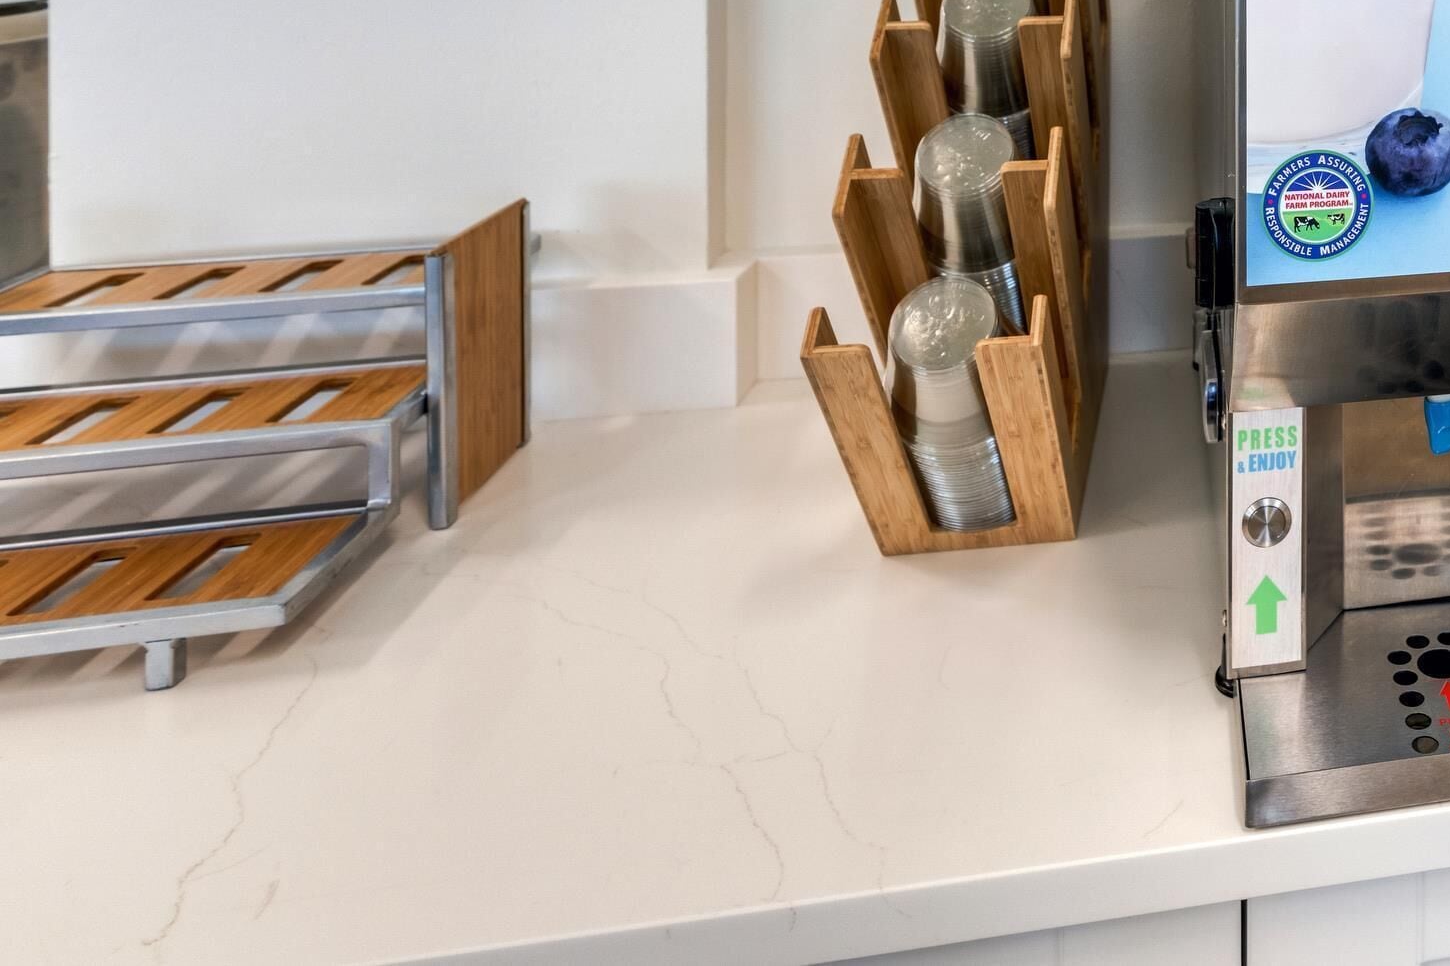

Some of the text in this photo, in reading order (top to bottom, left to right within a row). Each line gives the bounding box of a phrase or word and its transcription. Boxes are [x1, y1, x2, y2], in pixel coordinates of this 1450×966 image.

[1268, 155, 1366, 196] FARMERS ASSURING
[1284, 191, 1350, 201] NATIONAL DAIRY
[1285, 200, 1349, 209] FARM PROGRAM
[1265, 203, 1369, 256] RESPONSIBLE MANAGEMENT
[1237, 425, 1297, 451] PRESS
[1237, 450, 1297, 473] & ENJOY
